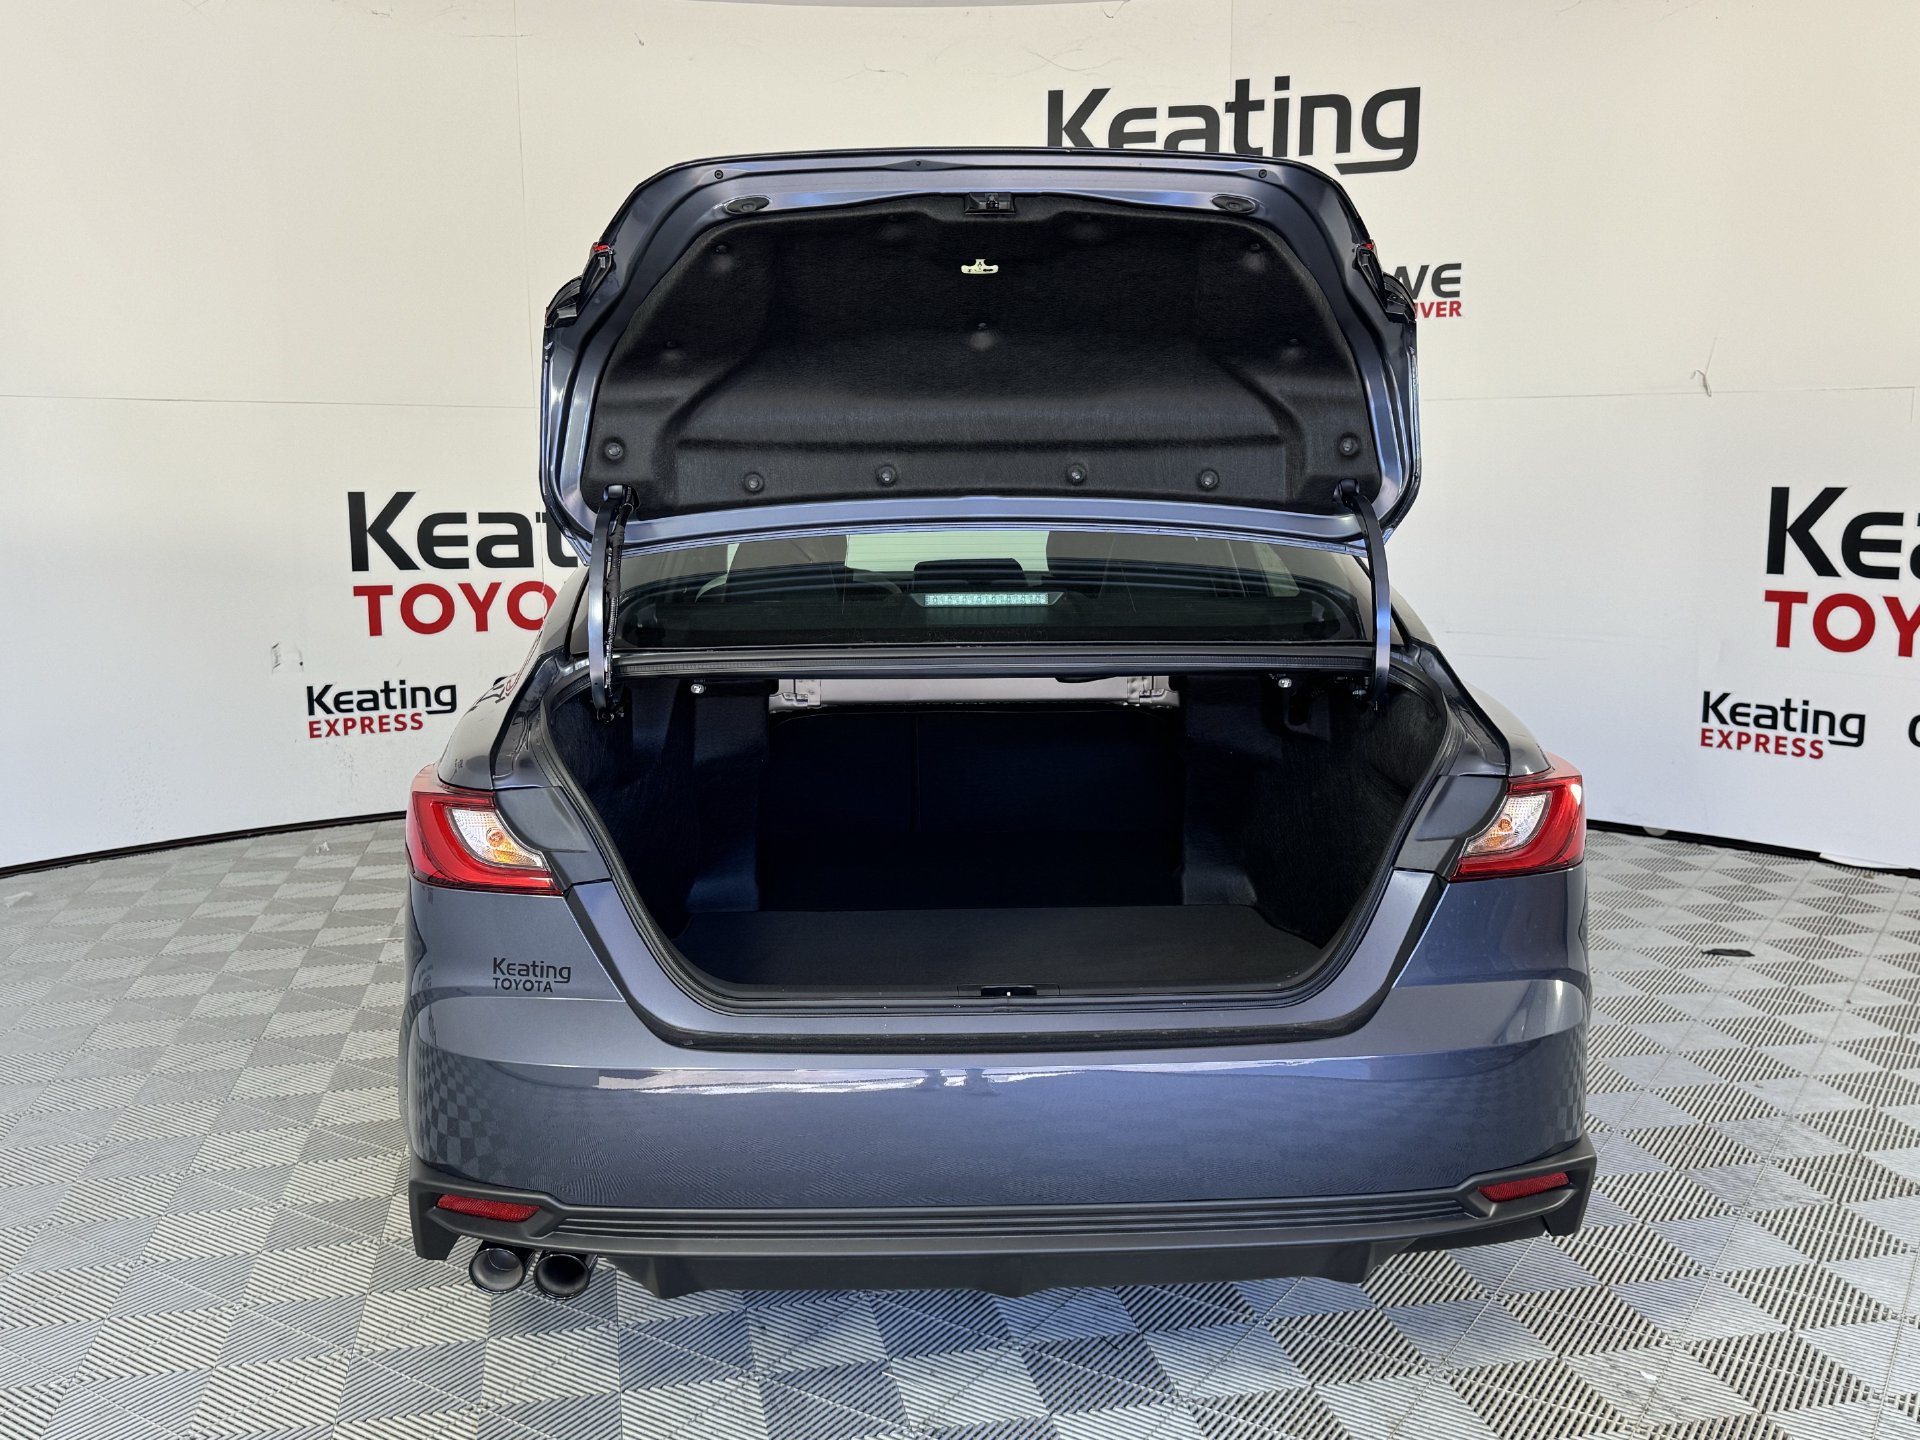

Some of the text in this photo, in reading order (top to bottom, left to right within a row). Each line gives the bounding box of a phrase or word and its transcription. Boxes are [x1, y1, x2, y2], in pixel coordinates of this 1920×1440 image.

[1047, 75, 1421, 175] Keating
[1766, 486, 1920, 580] Ke
[353, 581, 557, 637] TOYO
[306, 679, 457, 716] Keating
[308, 712, 425, 739] EXPRESS
[1701, 690, 1866, 748] Keating
[1700, 728, 1824, 760] EXPRESS
[492, 957, 571, 984] Keating
[492, 977, 553, 993] TOYOTA
